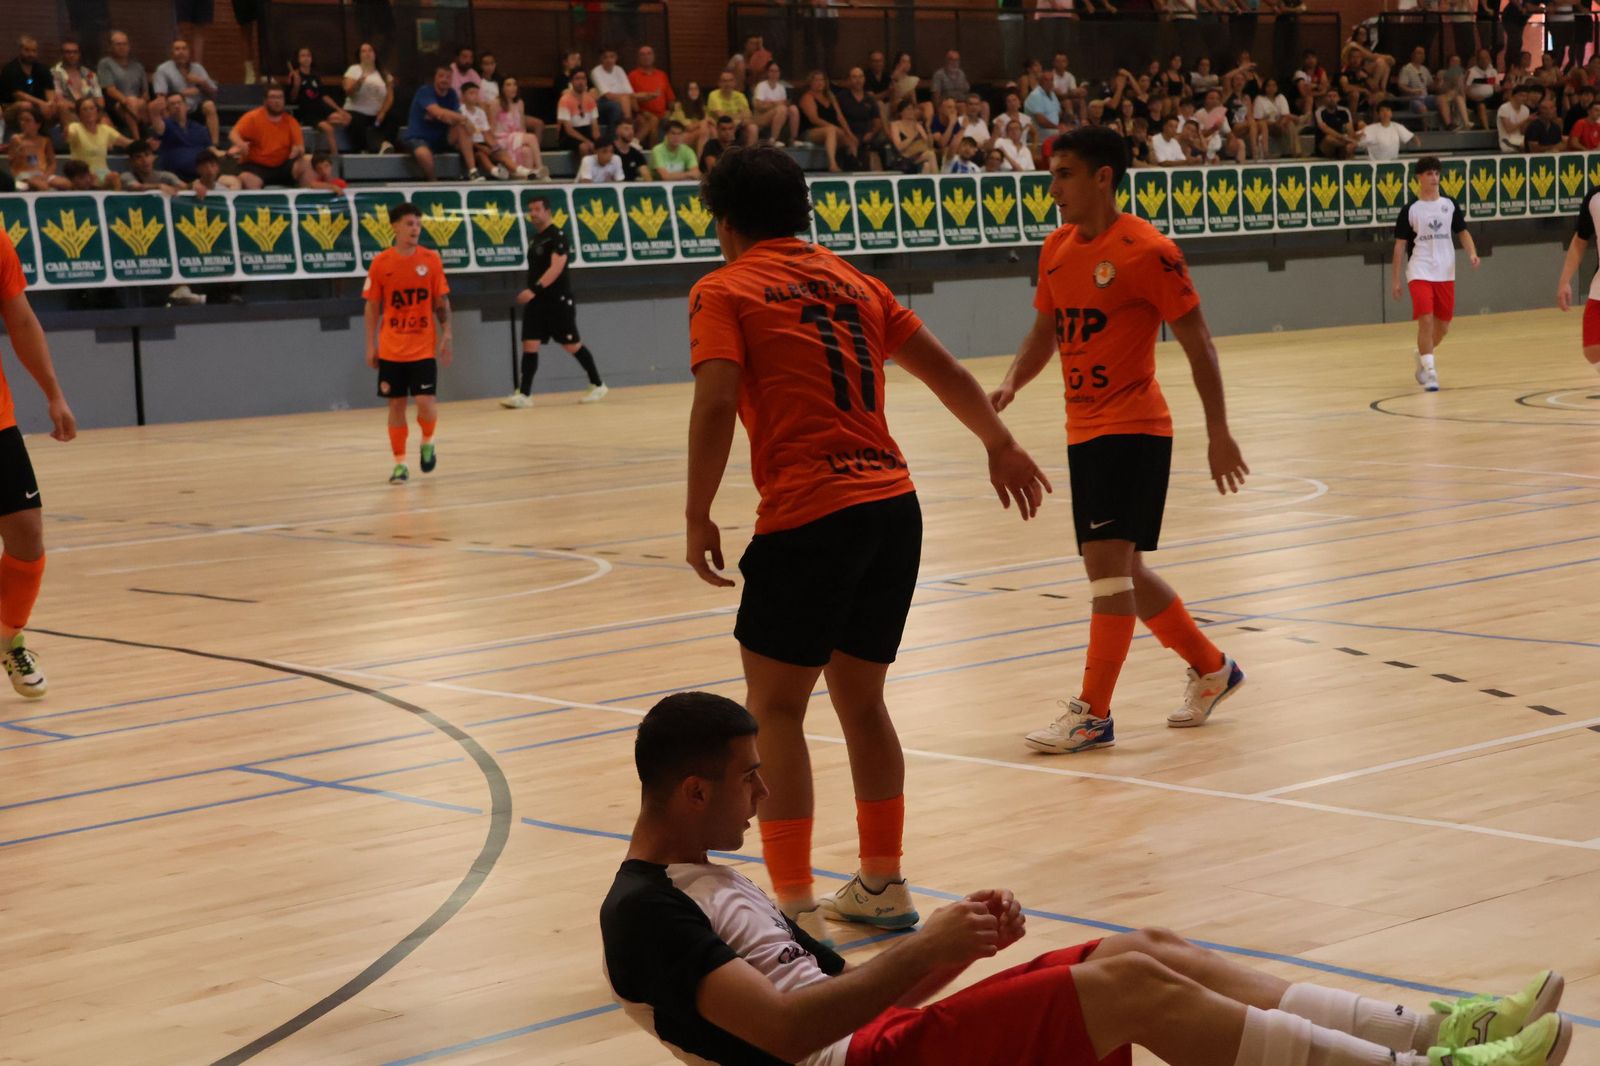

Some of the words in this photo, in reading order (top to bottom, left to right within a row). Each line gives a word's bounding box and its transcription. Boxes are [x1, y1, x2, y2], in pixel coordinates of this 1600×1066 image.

[303, 252, 323, 263] CAJA
[476, 247, 496, 257] CAJA
[113, 259, 137, 270] CAJA
[139, 257, 171, 268] RURAL
[179, 256, 201, 267] CAJA
[203, 255, 234, 266] RURAL
[242, 254, 264, 265] CAJA
[265, 253, 295, 264] RURAL
[45, 261, 70, 273] CAJA
[71, 260, 105, 271] RURAL
[391, 288, 429, 307] ATP
[800, 303, 876, 412] 11
